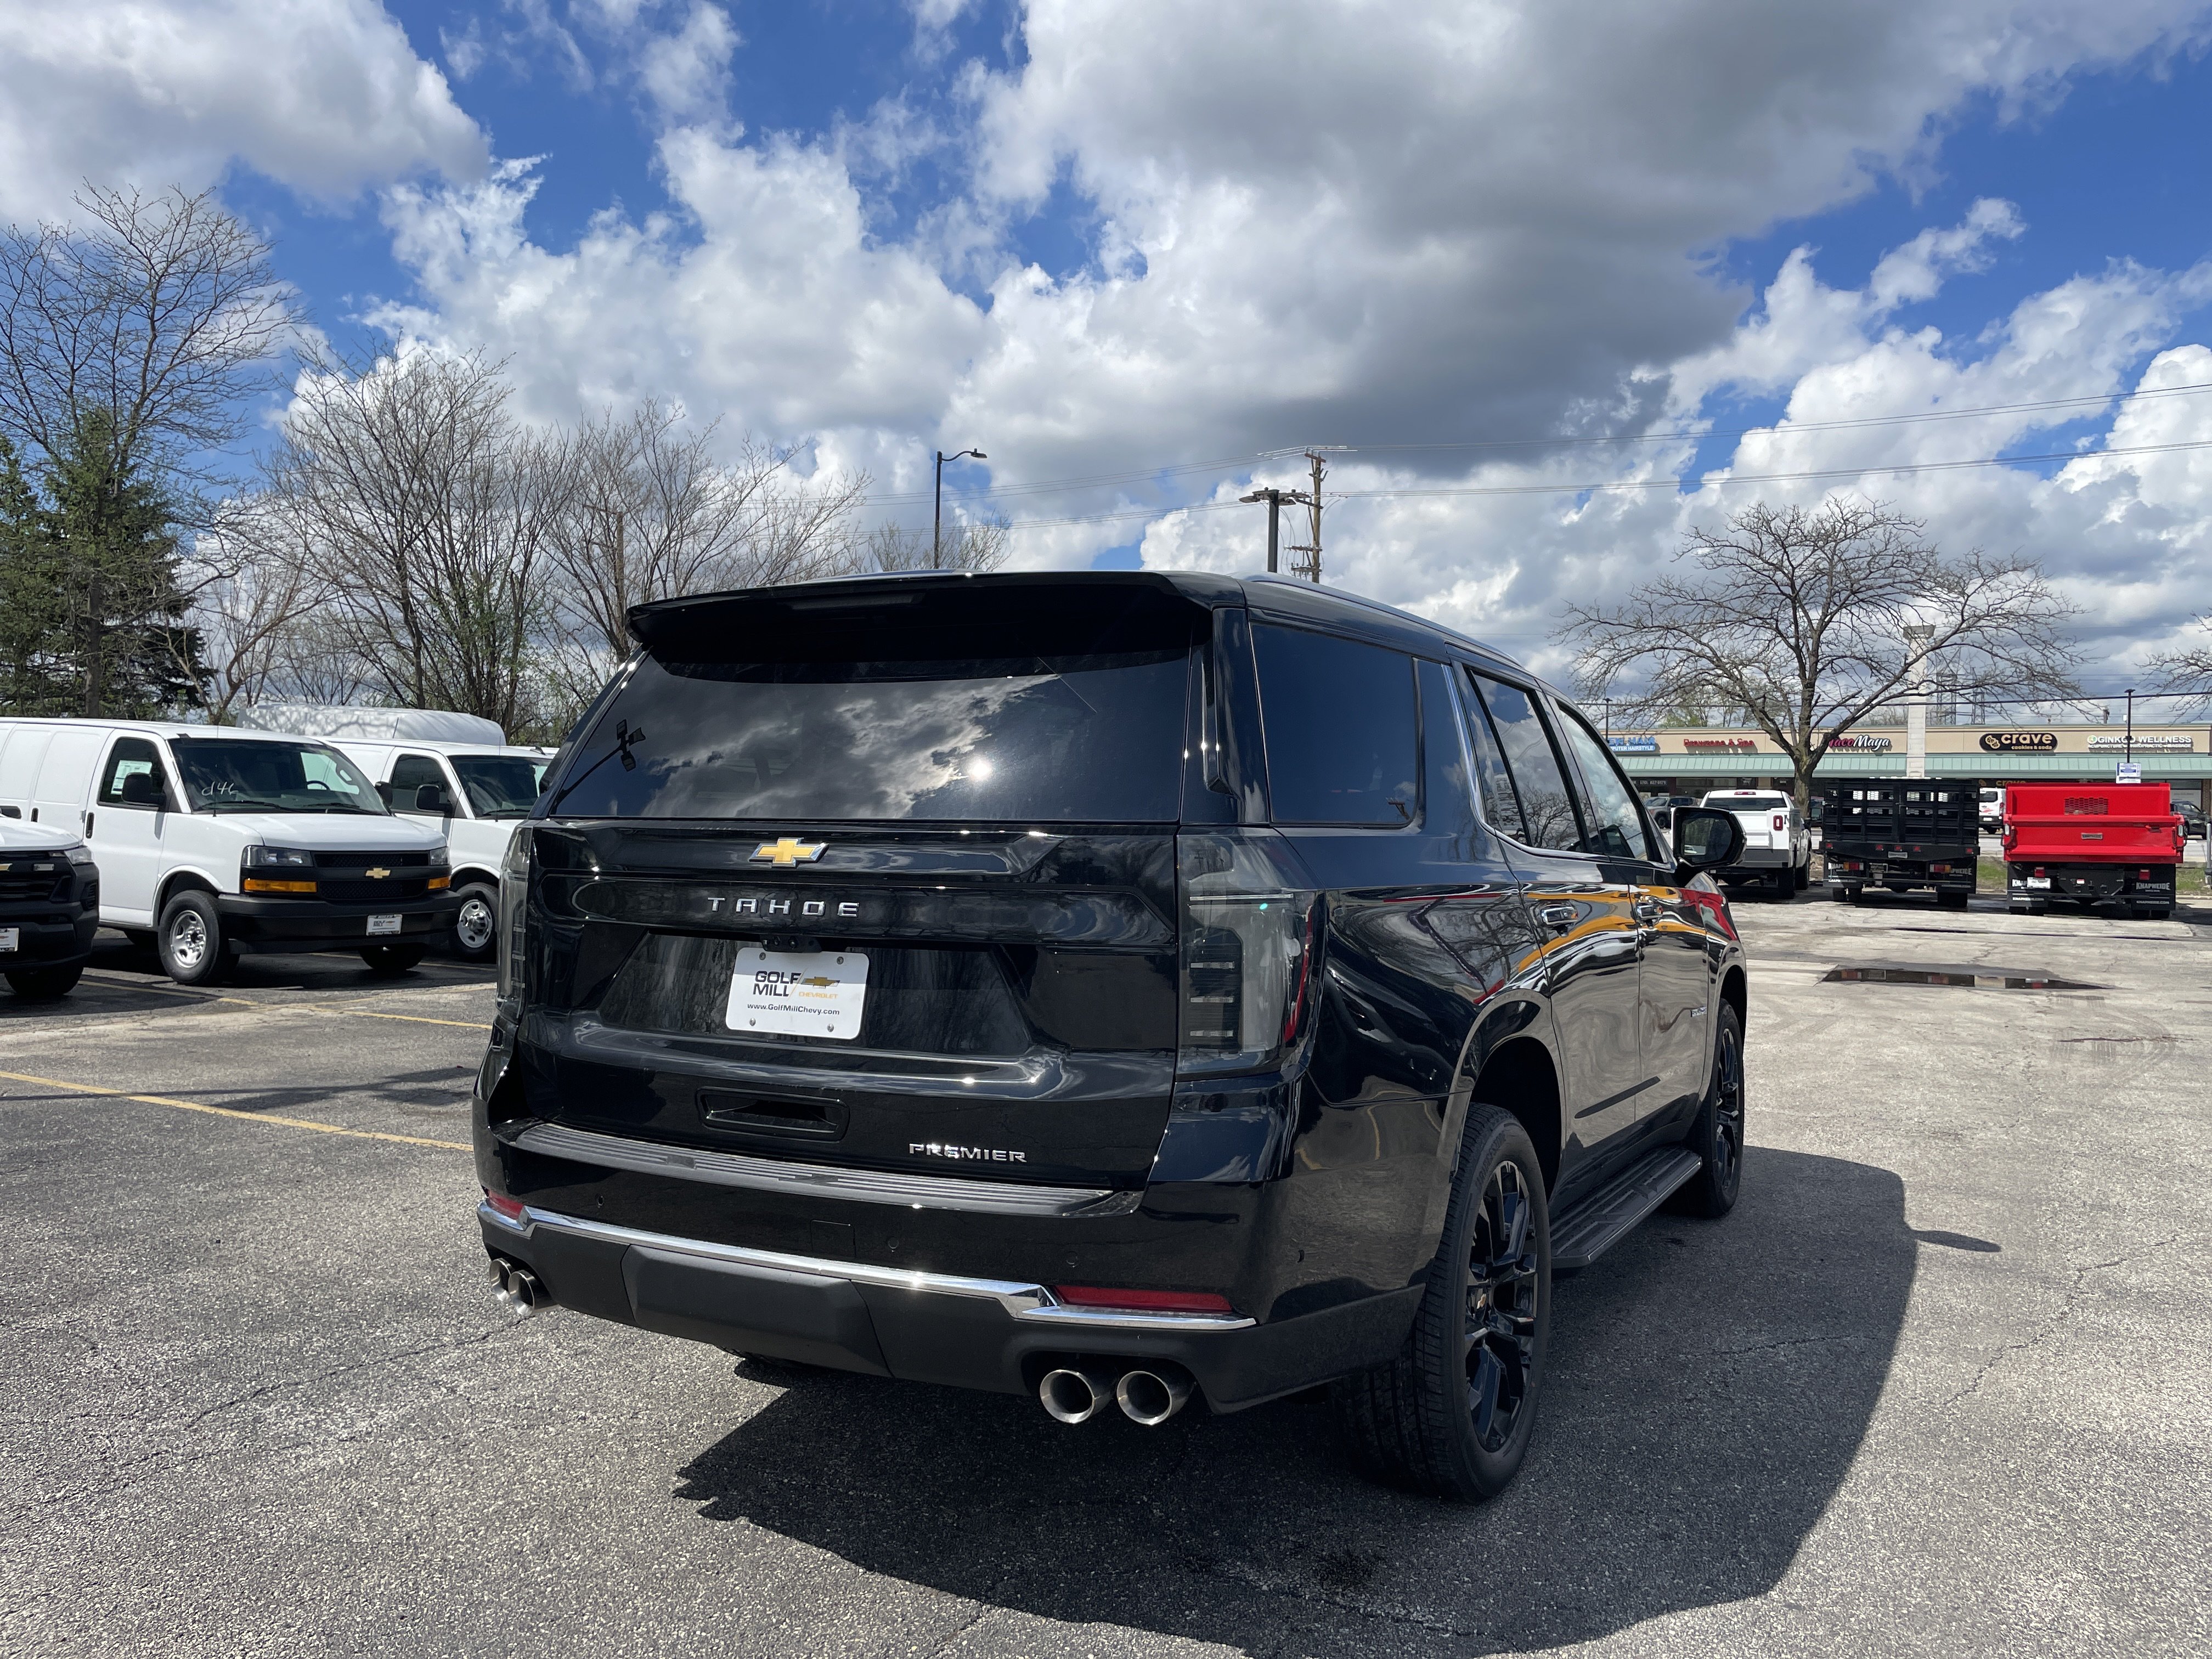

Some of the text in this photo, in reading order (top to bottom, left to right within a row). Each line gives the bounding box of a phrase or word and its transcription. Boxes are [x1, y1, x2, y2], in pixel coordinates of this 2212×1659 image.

[1628, 737, 1656, 745] HAIR
[1728, 738, 1735, 747] &
[1737, 738, 1755, 748] Spa
[2000, 733, 2053, 744] crave
[708, 898, 860, 917] TAHOE
[755, 970, 802, 985] GOLF
[753, 983, 789, 997] MILL
[798, 991, 838, 1000] CHEVROLET
[747, 1003, 840, 1015] www.GolfMillChevy.com
[909, 1143, 1027, 1163] PREMIER
